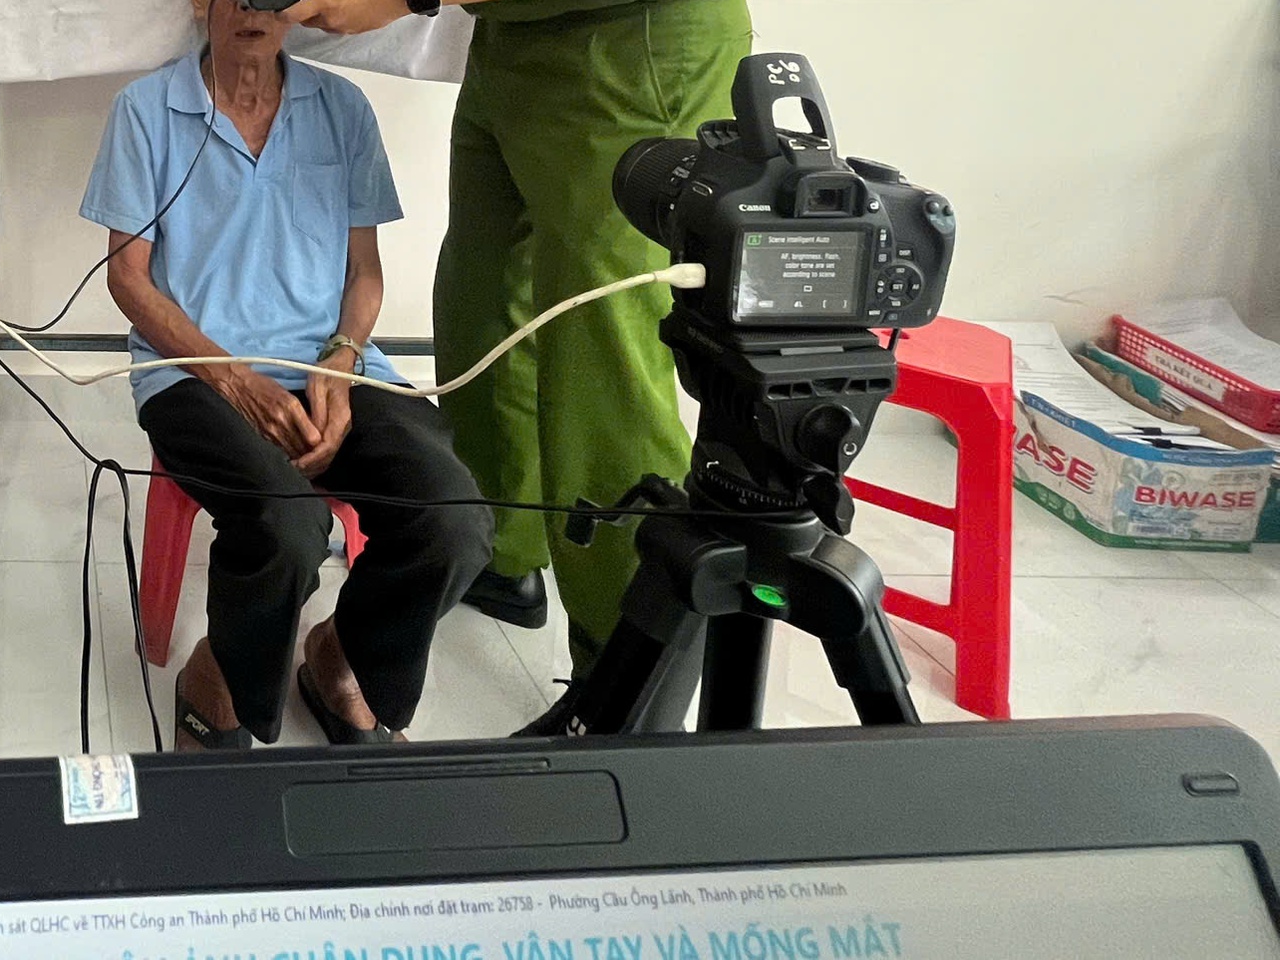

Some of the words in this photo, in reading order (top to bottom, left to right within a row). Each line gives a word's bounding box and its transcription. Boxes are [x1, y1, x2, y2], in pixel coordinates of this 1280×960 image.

[738, 203, 771, 212] Canon
[1015, 431, 1098, 495] ASE
[1133, 485, 1256, 509] BIWASE
[586, 933, 642, 960] TAY
[655, 924, 700, 960] VÀ
[828, 914, 902, 958] MẮT
